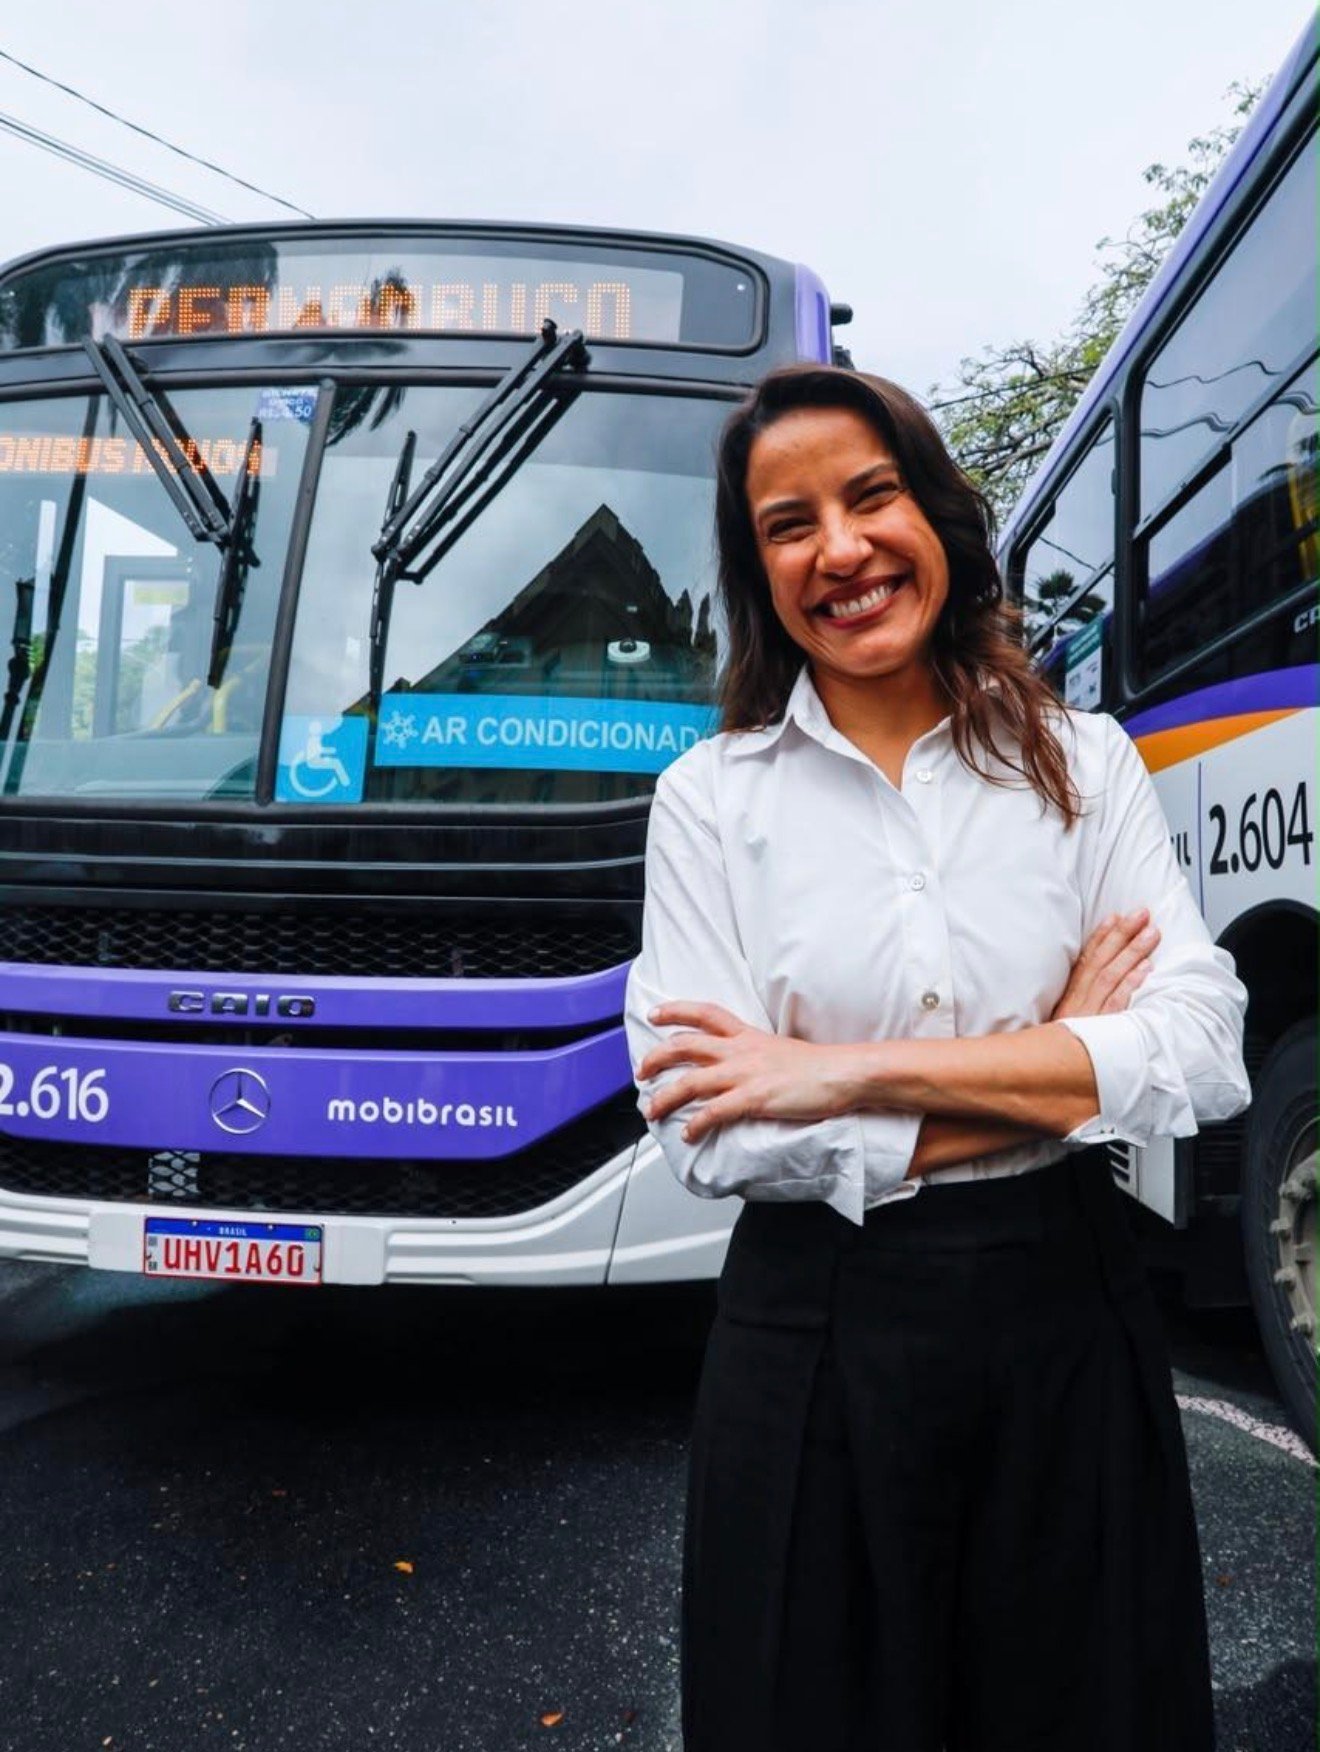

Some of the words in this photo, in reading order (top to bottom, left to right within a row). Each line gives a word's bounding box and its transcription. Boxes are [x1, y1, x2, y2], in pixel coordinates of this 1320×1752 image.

[421, 716, 468, 746] AR
[477, 716, 699, 752] CONDICIONAD
[1208, 781, 1314, 875] 2.604
[168, 990, 316, 1018] CAIO
[327, 1096, 518, 1127] mobibrasil
[163, 1237, 305, 1277] UHV1A60
